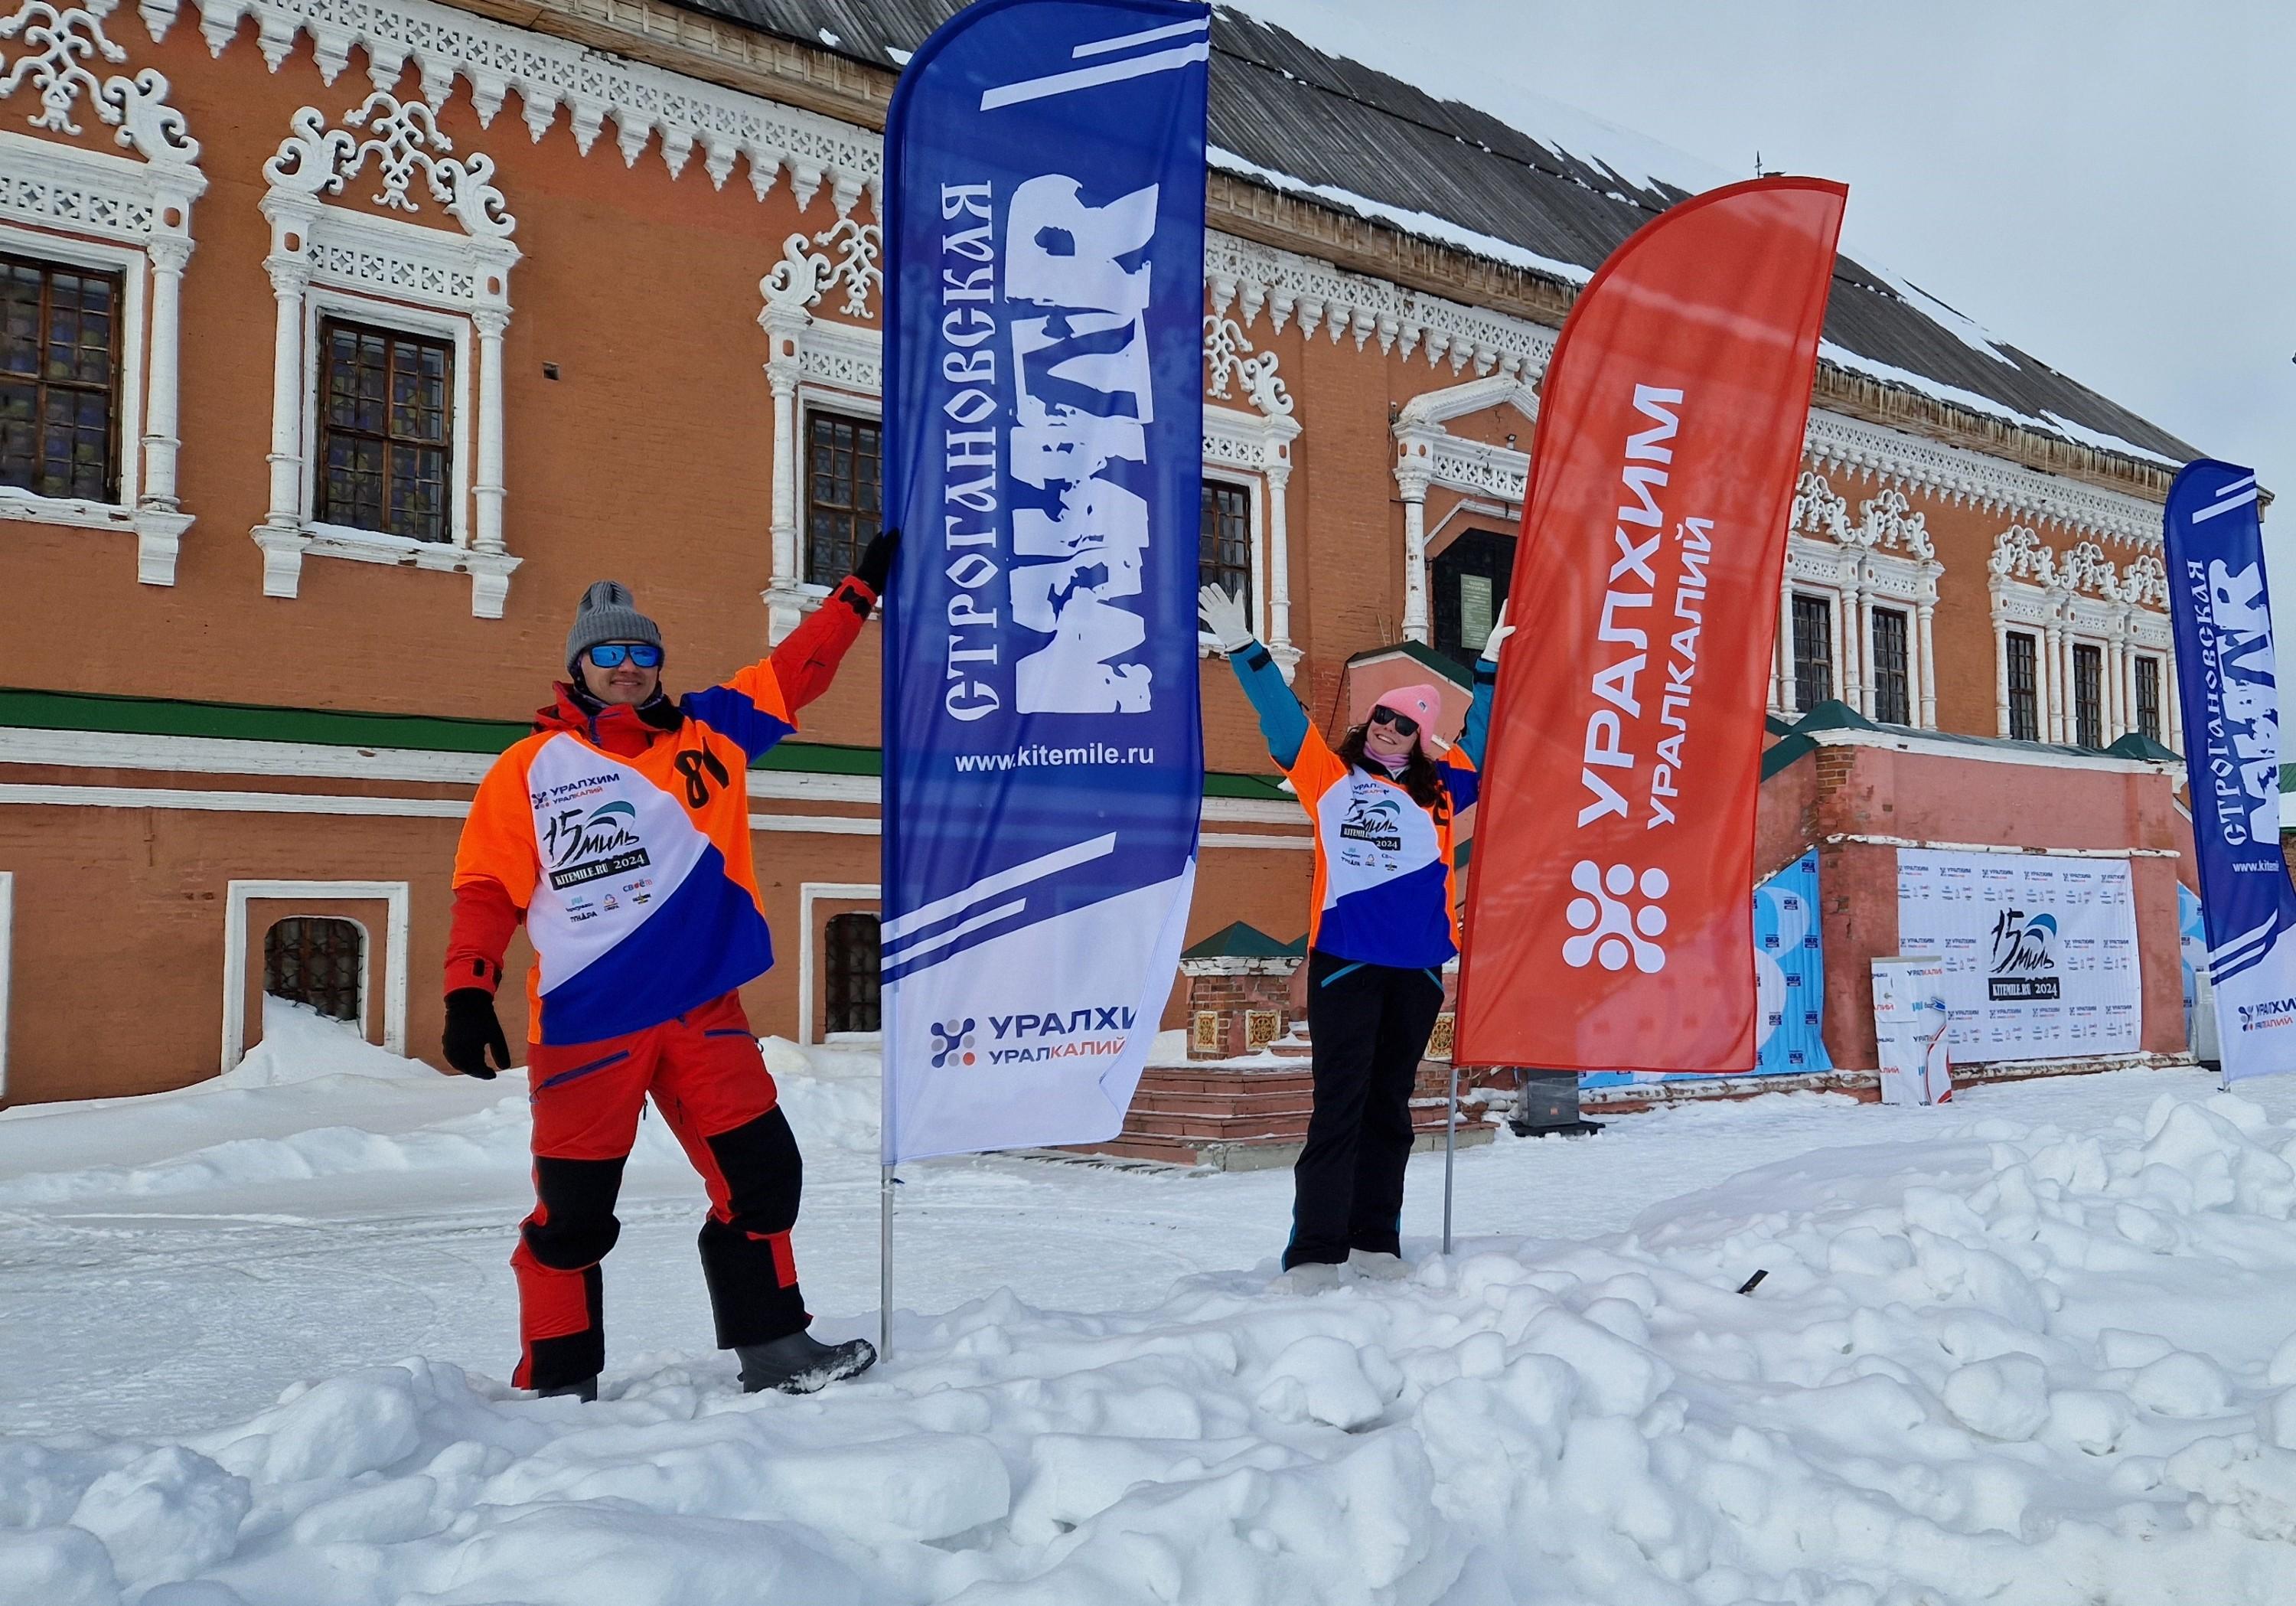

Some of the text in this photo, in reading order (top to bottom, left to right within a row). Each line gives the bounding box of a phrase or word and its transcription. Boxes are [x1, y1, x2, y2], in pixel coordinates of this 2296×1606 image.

[942, 180, 1000, 722] СТРОГАНОВСКАЯ
[1577, 384, 1684, 828] УРАЛХИМ
[1647, 517, 1714, 830] УРАЛКАЛИЙ
[673, 736, 729, 808] 81
[955, 743, 1153, 772] www.kitemile.ru
[550, 773, 620, 796] УРАЛХИМ
[553, 786, 603, 804] УРАЛКАЛИЙ
[543, 809, 583, 868] 15
[1376, 841, 1397, 849] 2024
[555, 854, 646, 886] KITEMILE.RU 2024
[1989, 907, 2024, 974] 15
[1992, 984, 2057, 997] KITEMILE.RU 2024
